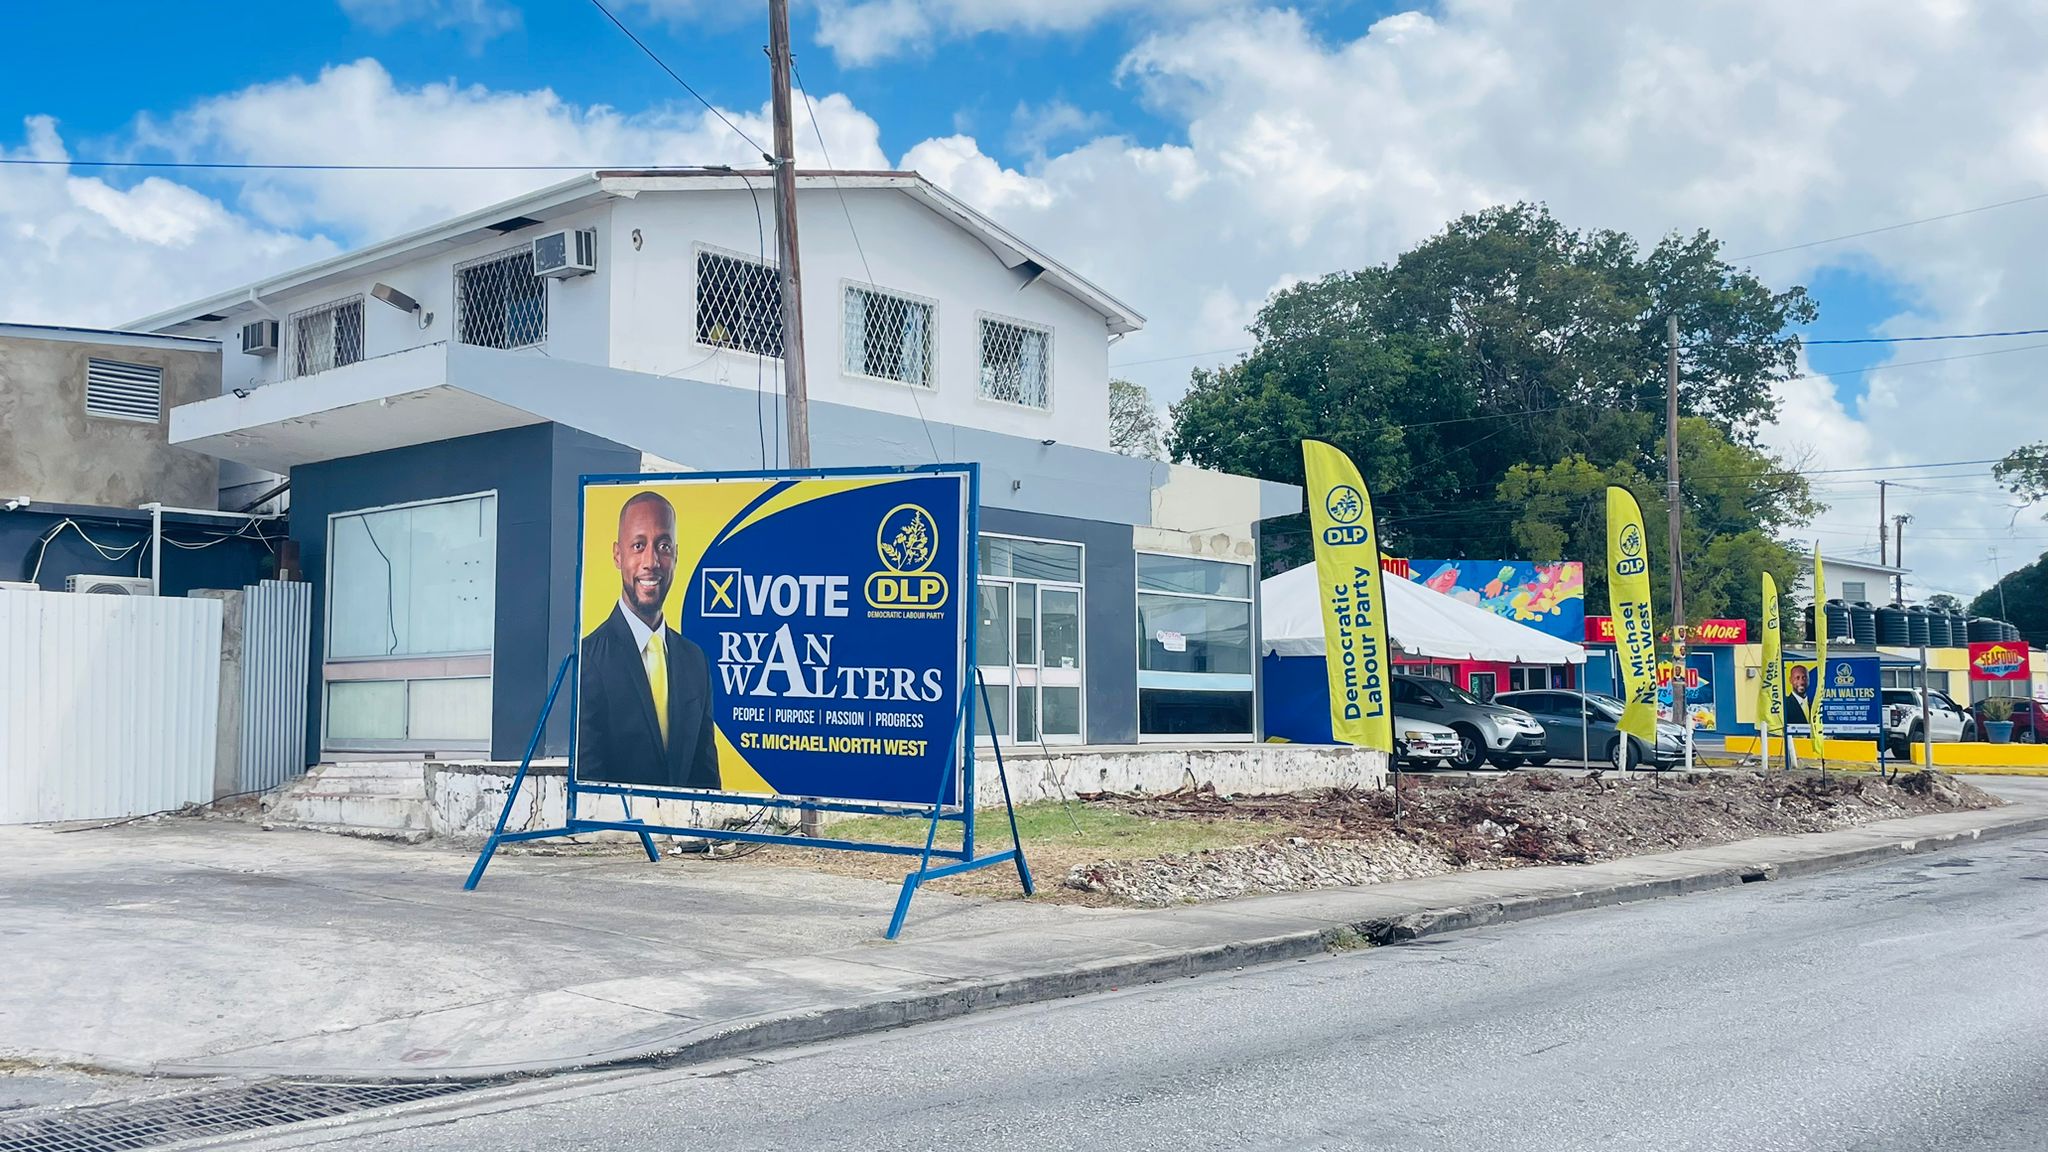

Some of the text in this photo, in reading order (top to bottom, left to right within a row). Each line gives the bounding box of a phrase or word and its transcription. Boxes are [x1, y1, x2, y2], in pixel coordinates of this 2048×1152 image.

[1328, 529, 1366, 544] DLP
[1619, 561, 1644, 574] DLP
[743, 575, 849, 617] VOTE
[877, 578, 941, 603] DLP
[867, 610, 945, 620] DEMOCRATIC LABOUR PARTY
[1353, 566, 1384, 718] Labour Party
[1619, 602, 1645, 677] Michael
[1703, 624, 1741, 639] MORE
[717, 623, 835, 680] RYAN
[1334, 584, 1362, 720] Democratic
[1637, 602, 1657, 704] North West
[1981, 651, 2019, 666] SEAFOOD
[717, 651, 943, 702] WALTERS
[1762, 662, 1775, 689] Vote
[1771, 685, 1782, 714] Ryan
[1822, 687, 1875, 698] YAN WALTERS
[732, 707, 924, 728] PEOPLE PURPOSE PASSION PROGRESS
[740, 732, 928, 757] ST. MICHAEL NORTH WEST
